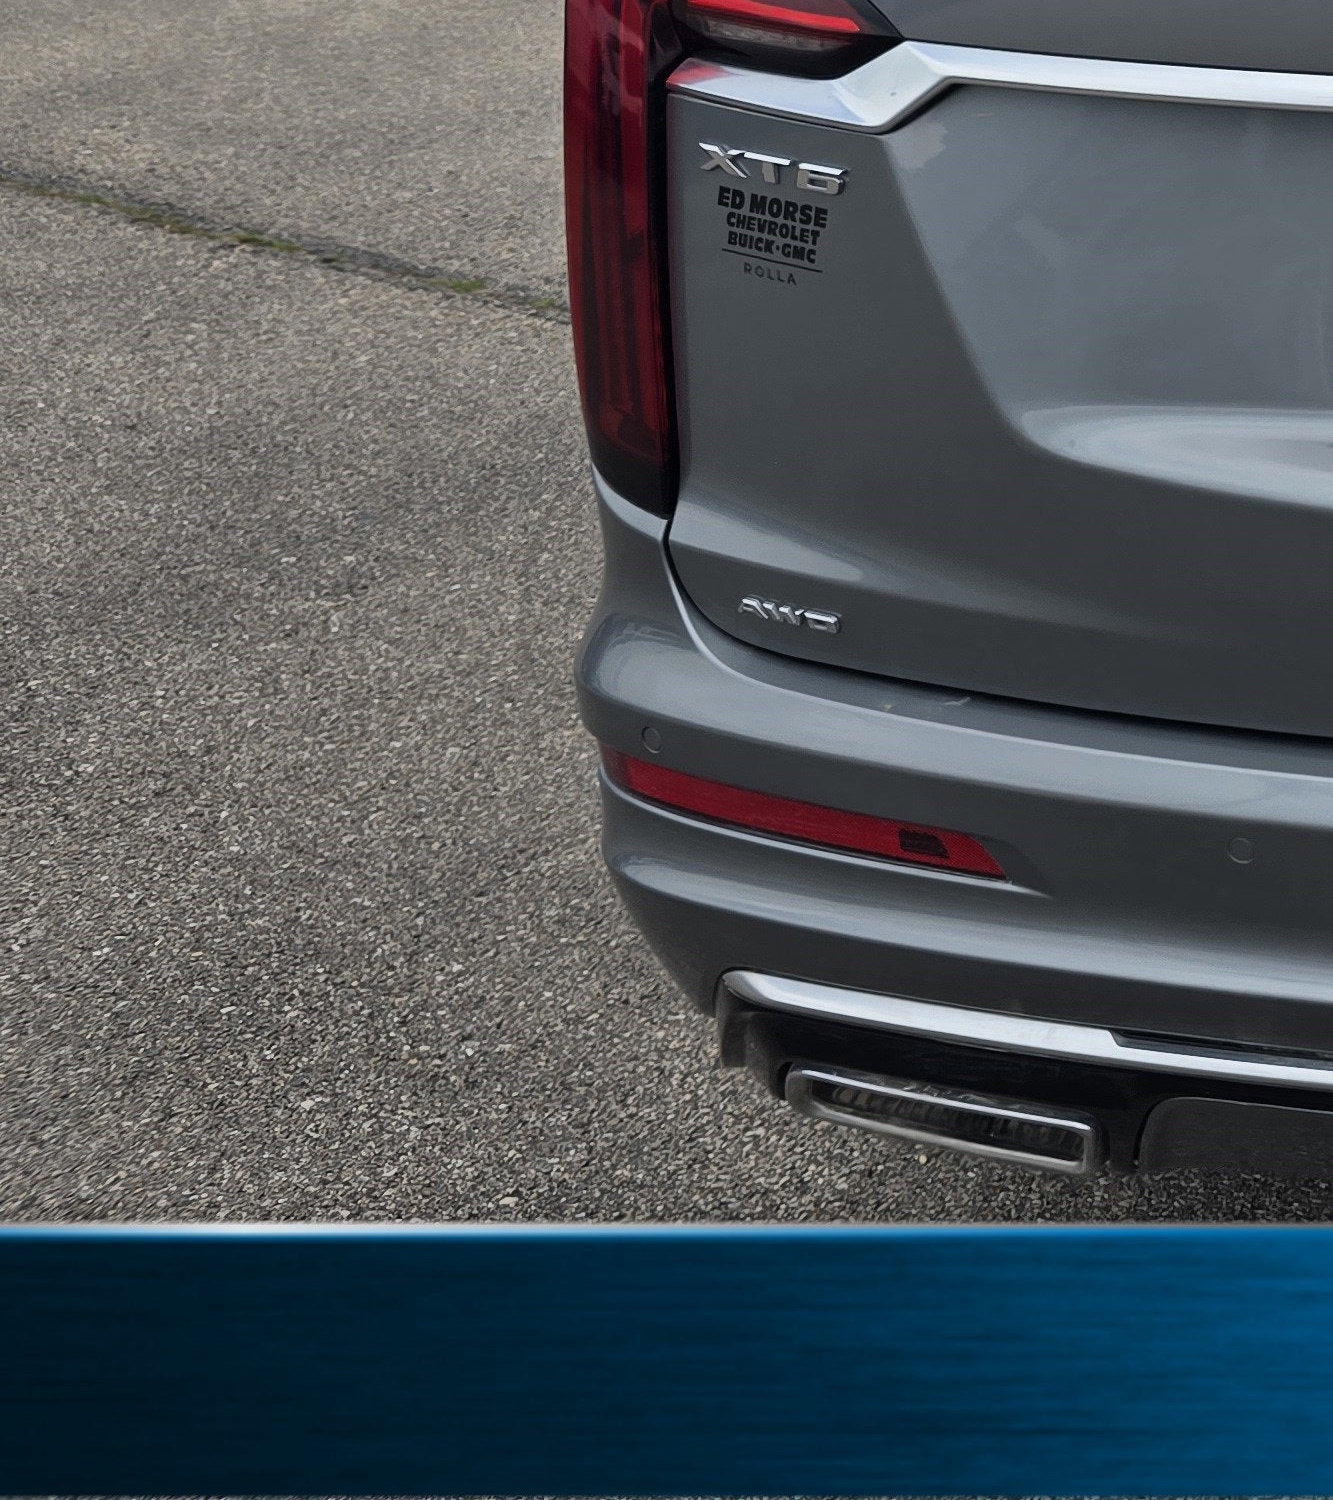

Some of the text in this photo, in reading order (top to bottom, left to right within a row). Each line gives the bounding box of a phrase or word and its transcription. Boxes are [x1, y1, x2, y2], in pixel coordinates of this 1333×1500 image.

[698, 141, 848, 197] XT6
[717, 185, 829, 229] ED MORSE
[726, 211, 821, 246] CHEVROLET
[743, 262, 798, 286] ROLLA
[737, 596, 843, 634] AWD
